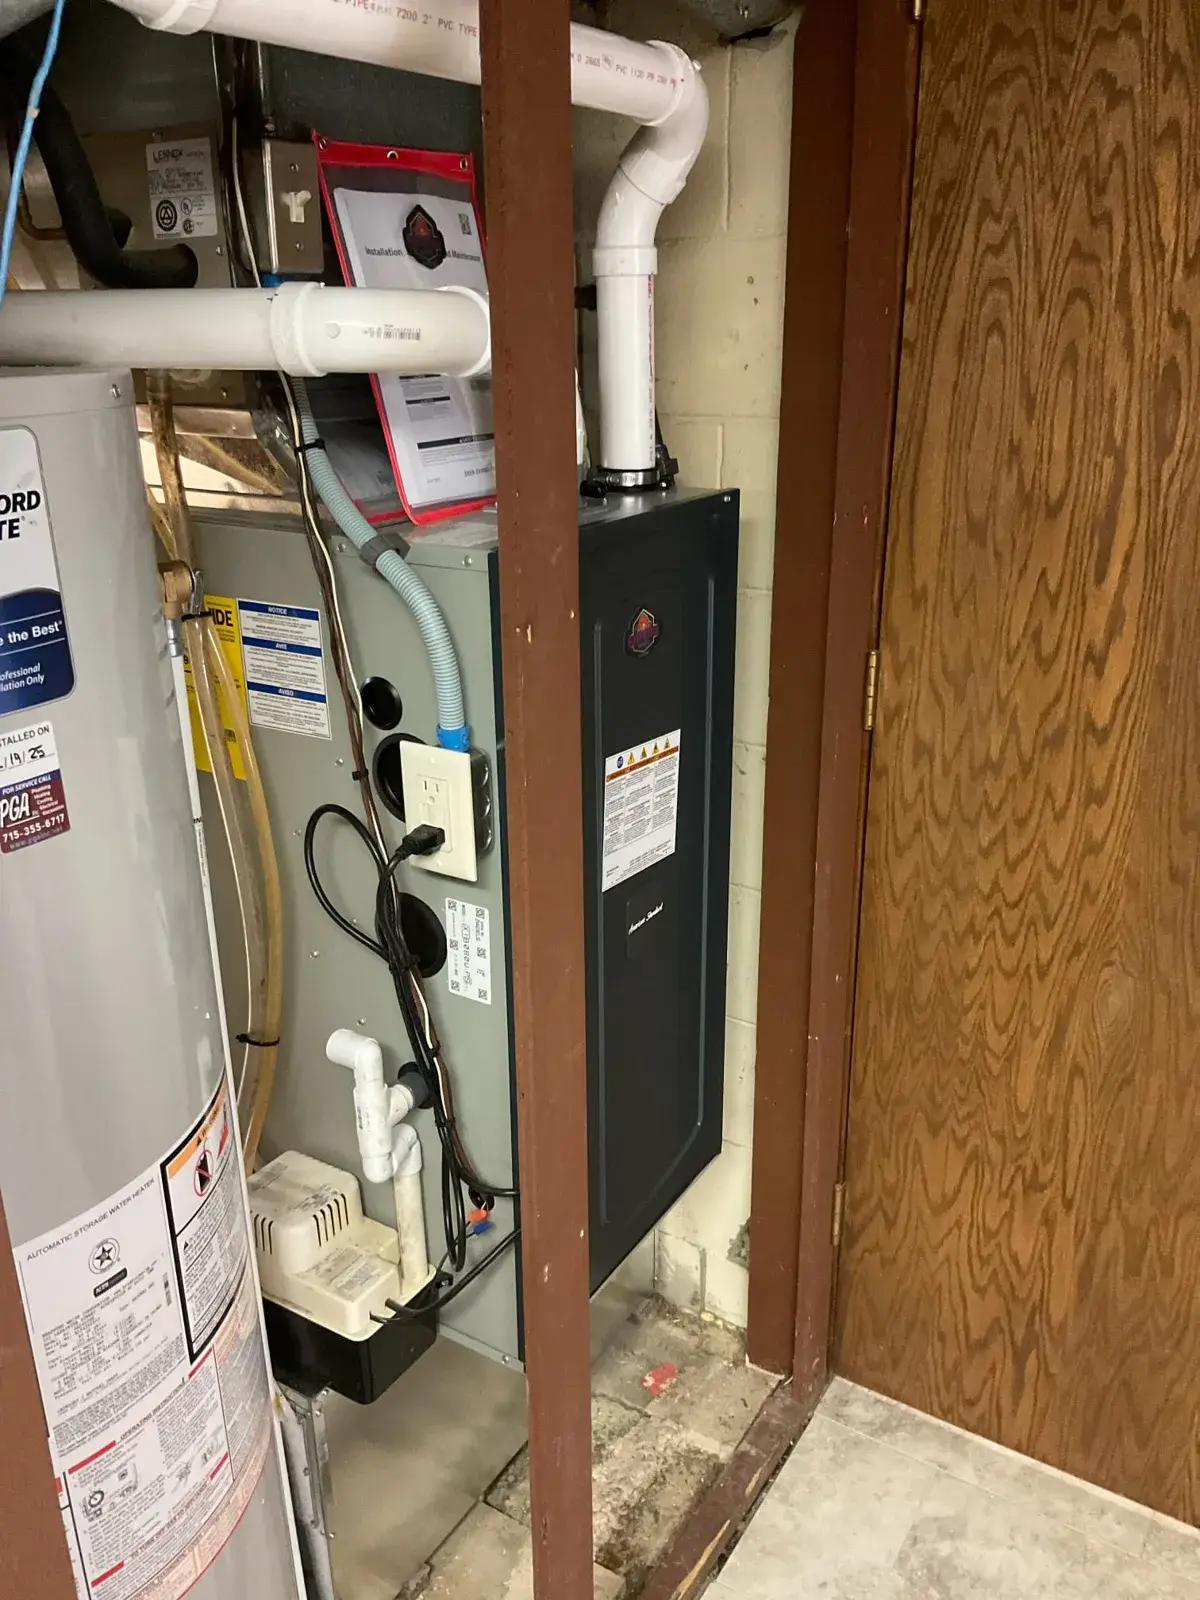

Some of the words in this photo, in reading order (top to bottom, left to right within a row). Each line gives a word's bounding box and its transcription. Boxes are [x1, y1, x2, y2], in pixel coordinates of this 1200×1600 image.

[396, 7, 418, 22] 7200
[437, 18, 453, 31] PVC
[459, 23, 478, 37] TYPE
[615, 63, 627, 75] PVC
[152, 148, 184, 164] LENNOX
[268, 606, 288, 616] NOTICE
[8, 631, 29, 644] the
[275, 642, 288, 651] AVIS
[26, 674, 45, 685] Only
[37, 725, 50, 736] ON
[2, 787, 14, 796] FOR
[15, 780, 38, 793] SERVICE
[38, 774, 52, 783] CALL
[0, 792, 31, 829] PGA
[2, 813, 65, 844] 715-355-6717
[26, 1234, 73, 1262] AUTOMATIC
[73, 1211, 109, 1238] STORAGE
[108, 1196, 132, 1216] WATER
[132, 1178, 155, 1200] HEATER
